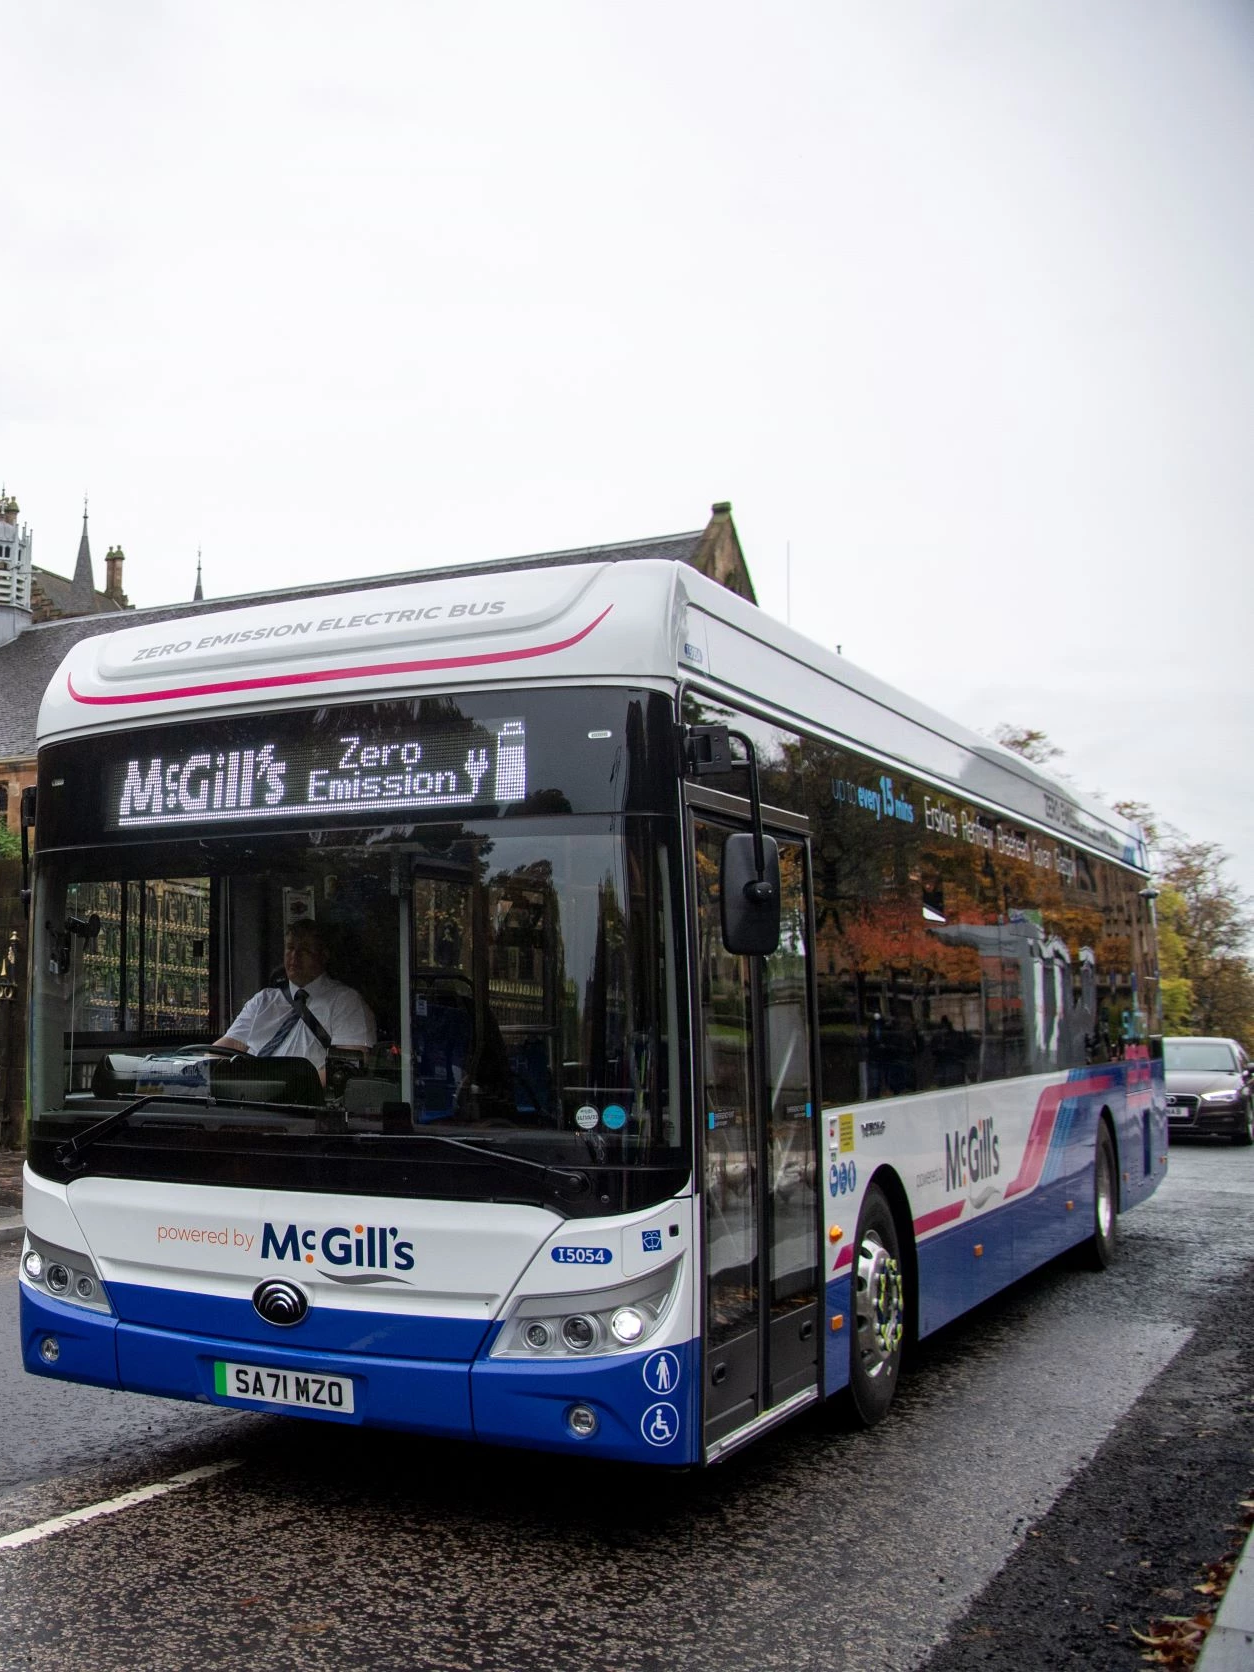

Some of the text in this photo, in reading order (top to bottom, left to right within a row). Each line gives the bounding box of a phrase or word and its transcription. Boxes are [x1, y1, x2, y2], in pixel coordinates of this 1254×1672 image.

[132, 600, 506, 662] ZERO EMISSION ELECTRIC BUS
[119, 743, 286, 816] McGill's
[338, 737, 423, 770] Zero
[307, 767, 457, 801] Emission
[858, 786, 881, 821] every
[880, 775, 895, 817] 15
[895, 793, 914, 823] mins
[924, 796, 957, 838] Erskine
[946, 1116, 1000, 1192] McGill's
[157, 1222, 415, 1271] powered by McGill's
[235, 1368, 343, 1407] SA71 MZO
